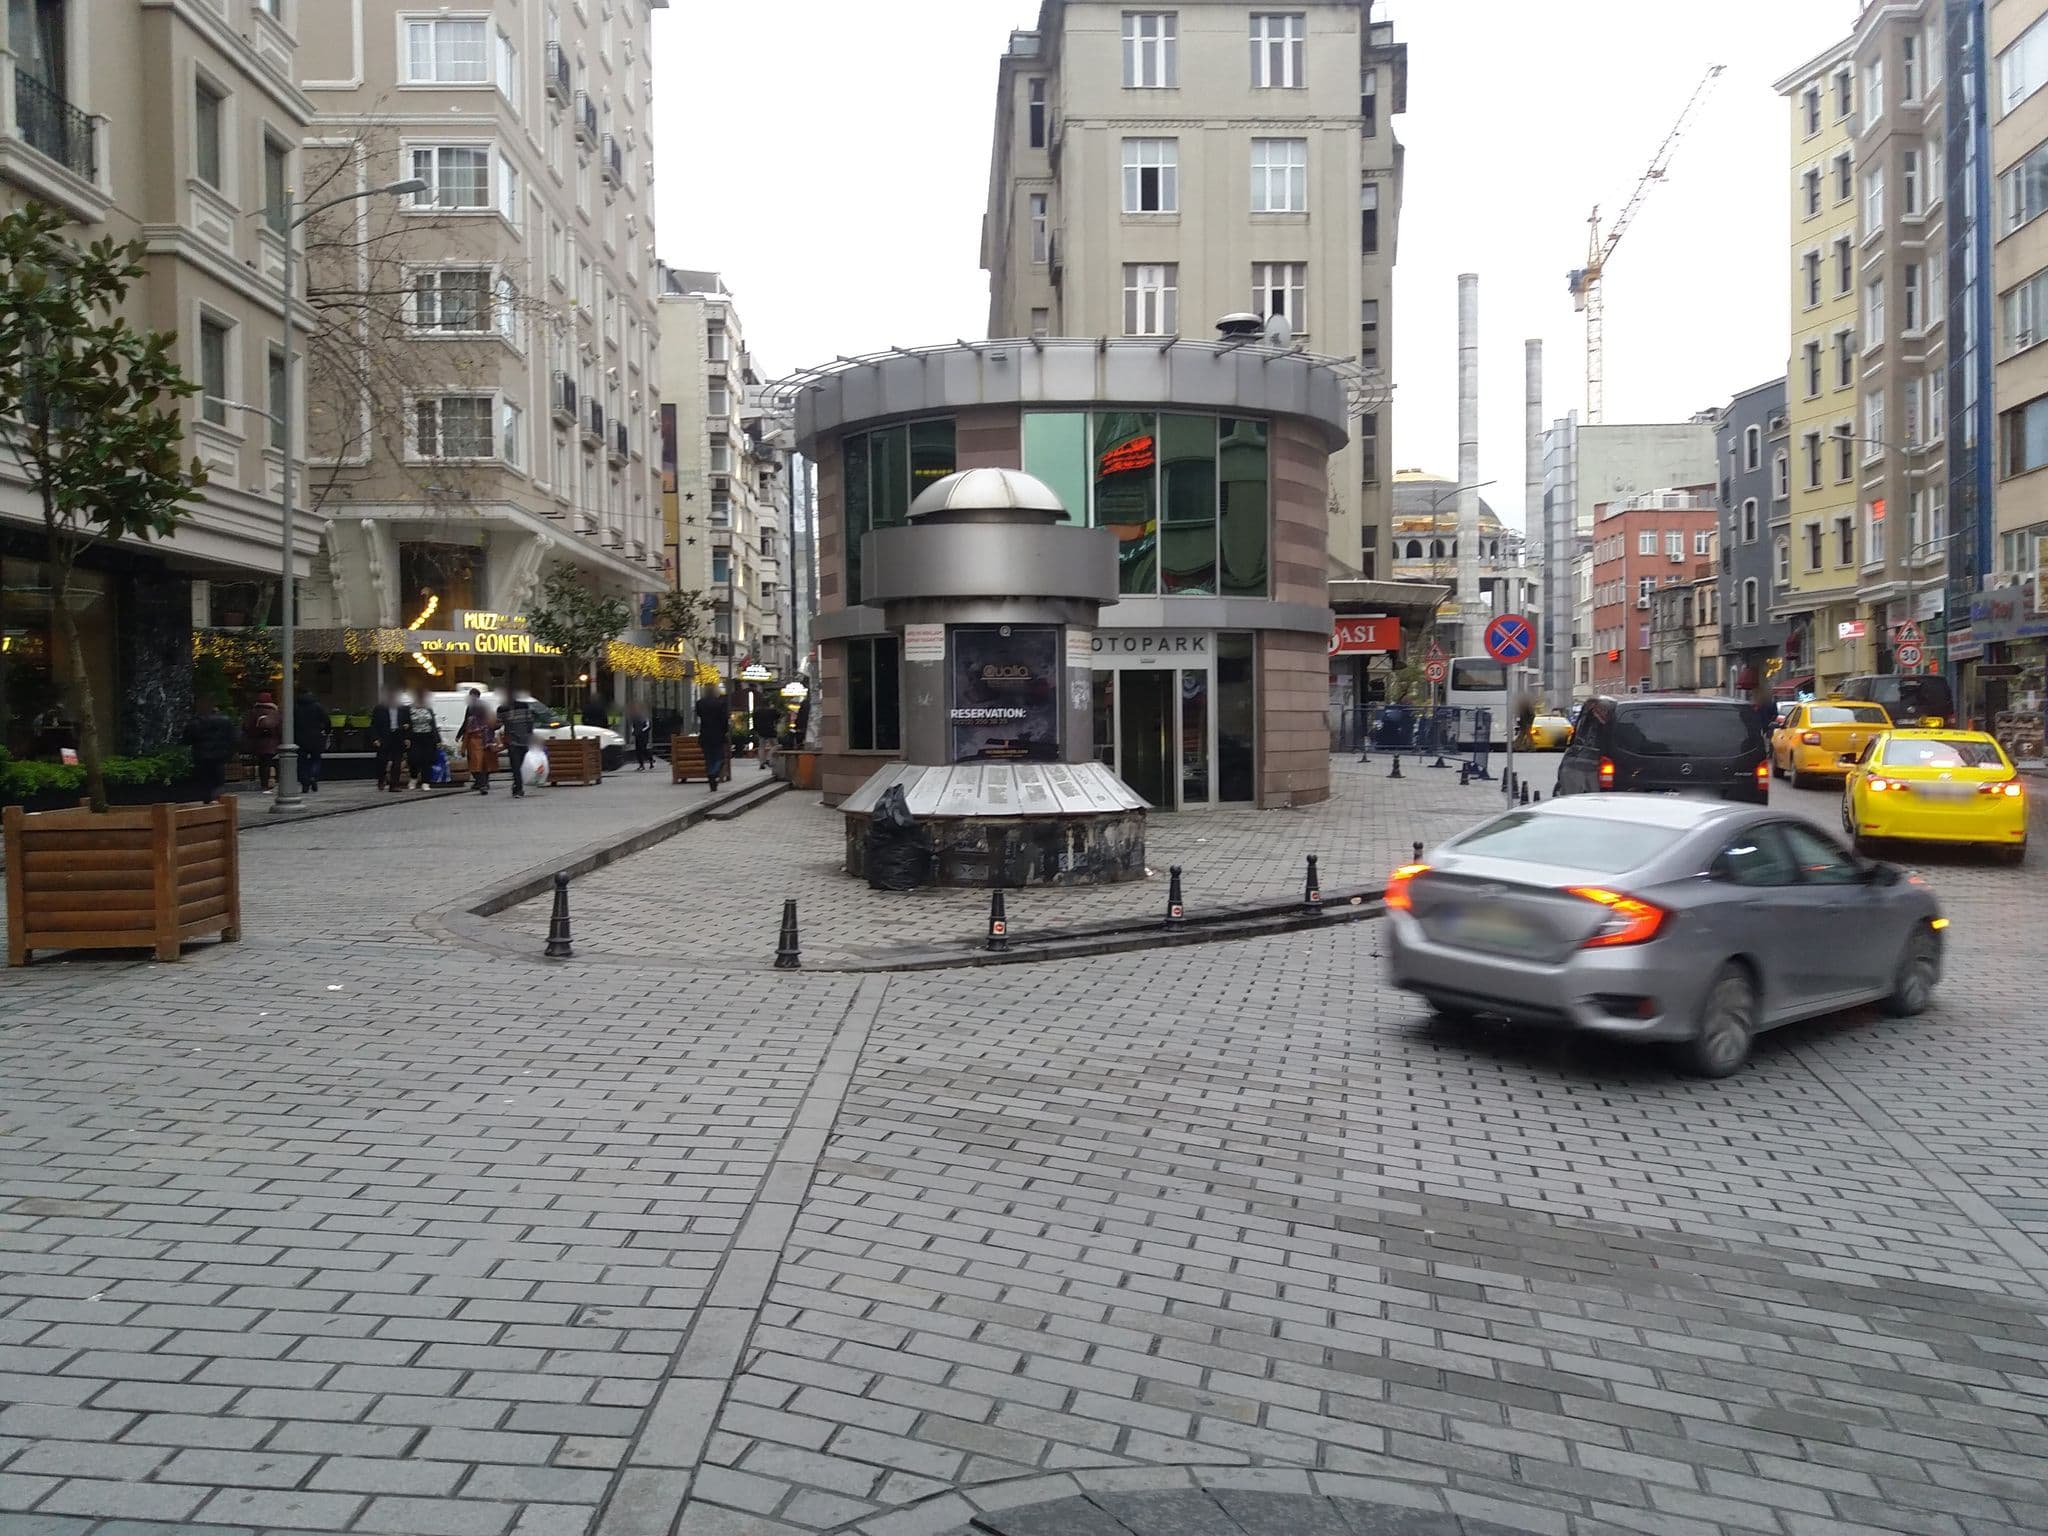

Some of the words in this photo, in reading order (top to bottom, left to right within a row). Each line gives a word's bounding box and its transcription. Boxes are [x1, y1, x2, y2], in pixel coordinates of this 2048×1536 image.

[1340, 625, 1377, 643] ASI
[1091, 637, 1205, 651] OTOPARK
[1902, 649, 1917, 661] 30
[1430, 667, 1441, 676] 30
[950, 708, 1027, 719] RESERVATION:
